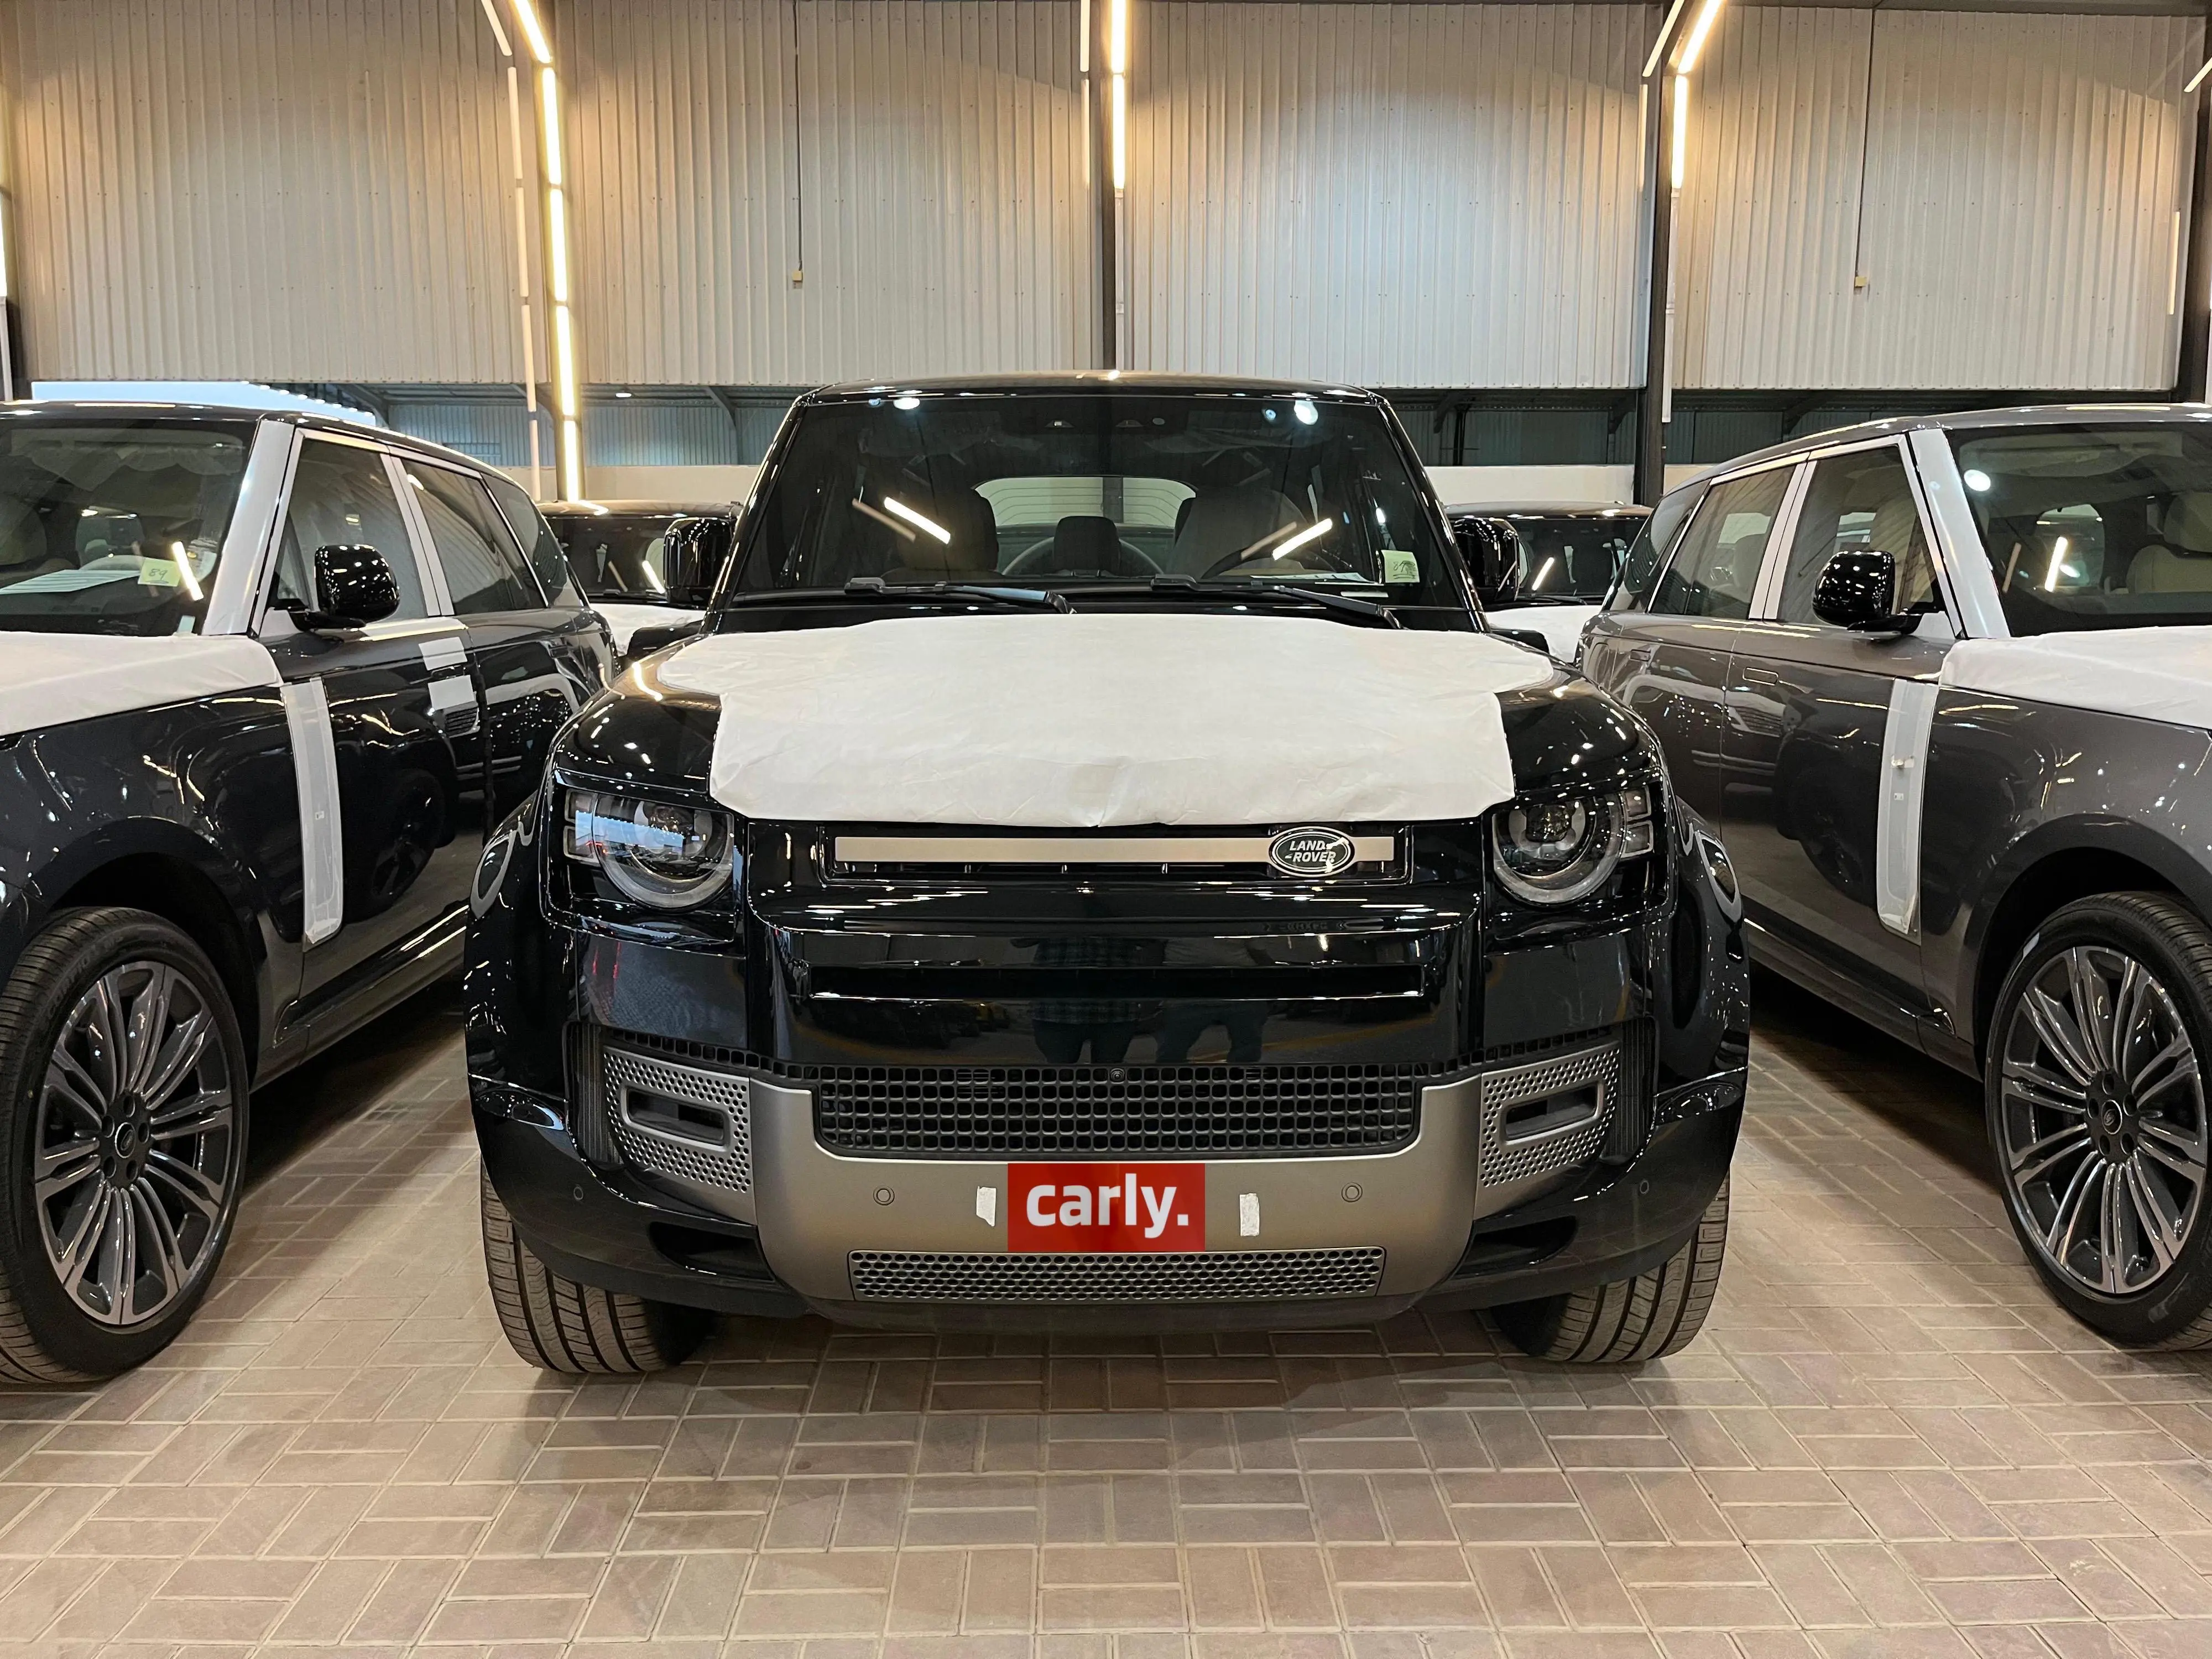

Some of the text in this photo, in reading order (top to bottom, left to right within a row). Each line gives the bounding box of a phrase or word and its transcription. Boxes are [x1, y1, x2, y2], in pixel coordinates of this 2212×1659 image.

[148, 568, 168, 581] 89
[1289, 840, 1325, 851] LAND
[1292, 851, 1337, 863] ROVER
[1026, 1173, 1189, 1239] carly.
